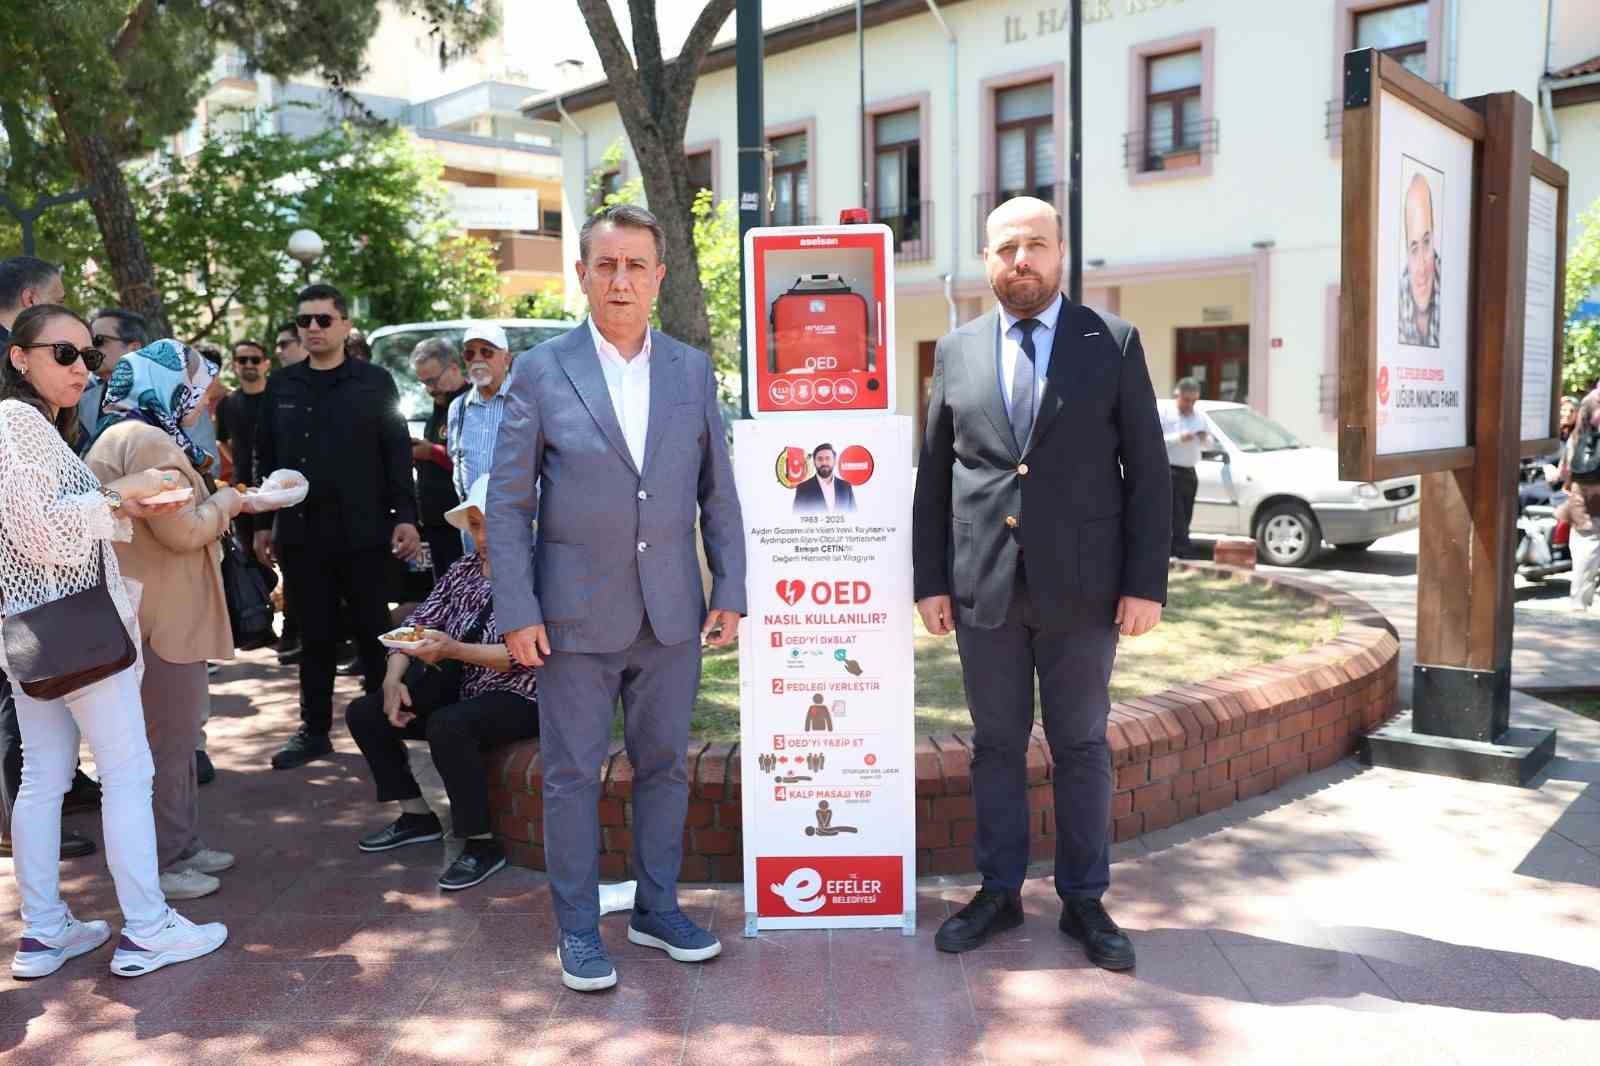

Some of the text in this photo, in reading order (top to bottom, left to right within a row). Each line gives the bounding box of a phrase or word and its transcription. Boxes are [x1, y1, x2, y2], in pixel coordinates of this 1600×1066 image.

[805, 357, 838, 370] OED
[811, 581, 872, 605] OED
[764, 612, 888, 625] NASIL KULLANILIR?
[772, 633, 782, 646] 1
[773, 680, 783, 693] 2
[774, 735, 784, 749] 3
[775, 786, 786, 800] 4
[789, 790, 814, 799] KALP
[826, 880, 882, 894] EFELER
[832, 894, 877, 904] BELEDİYESİ
